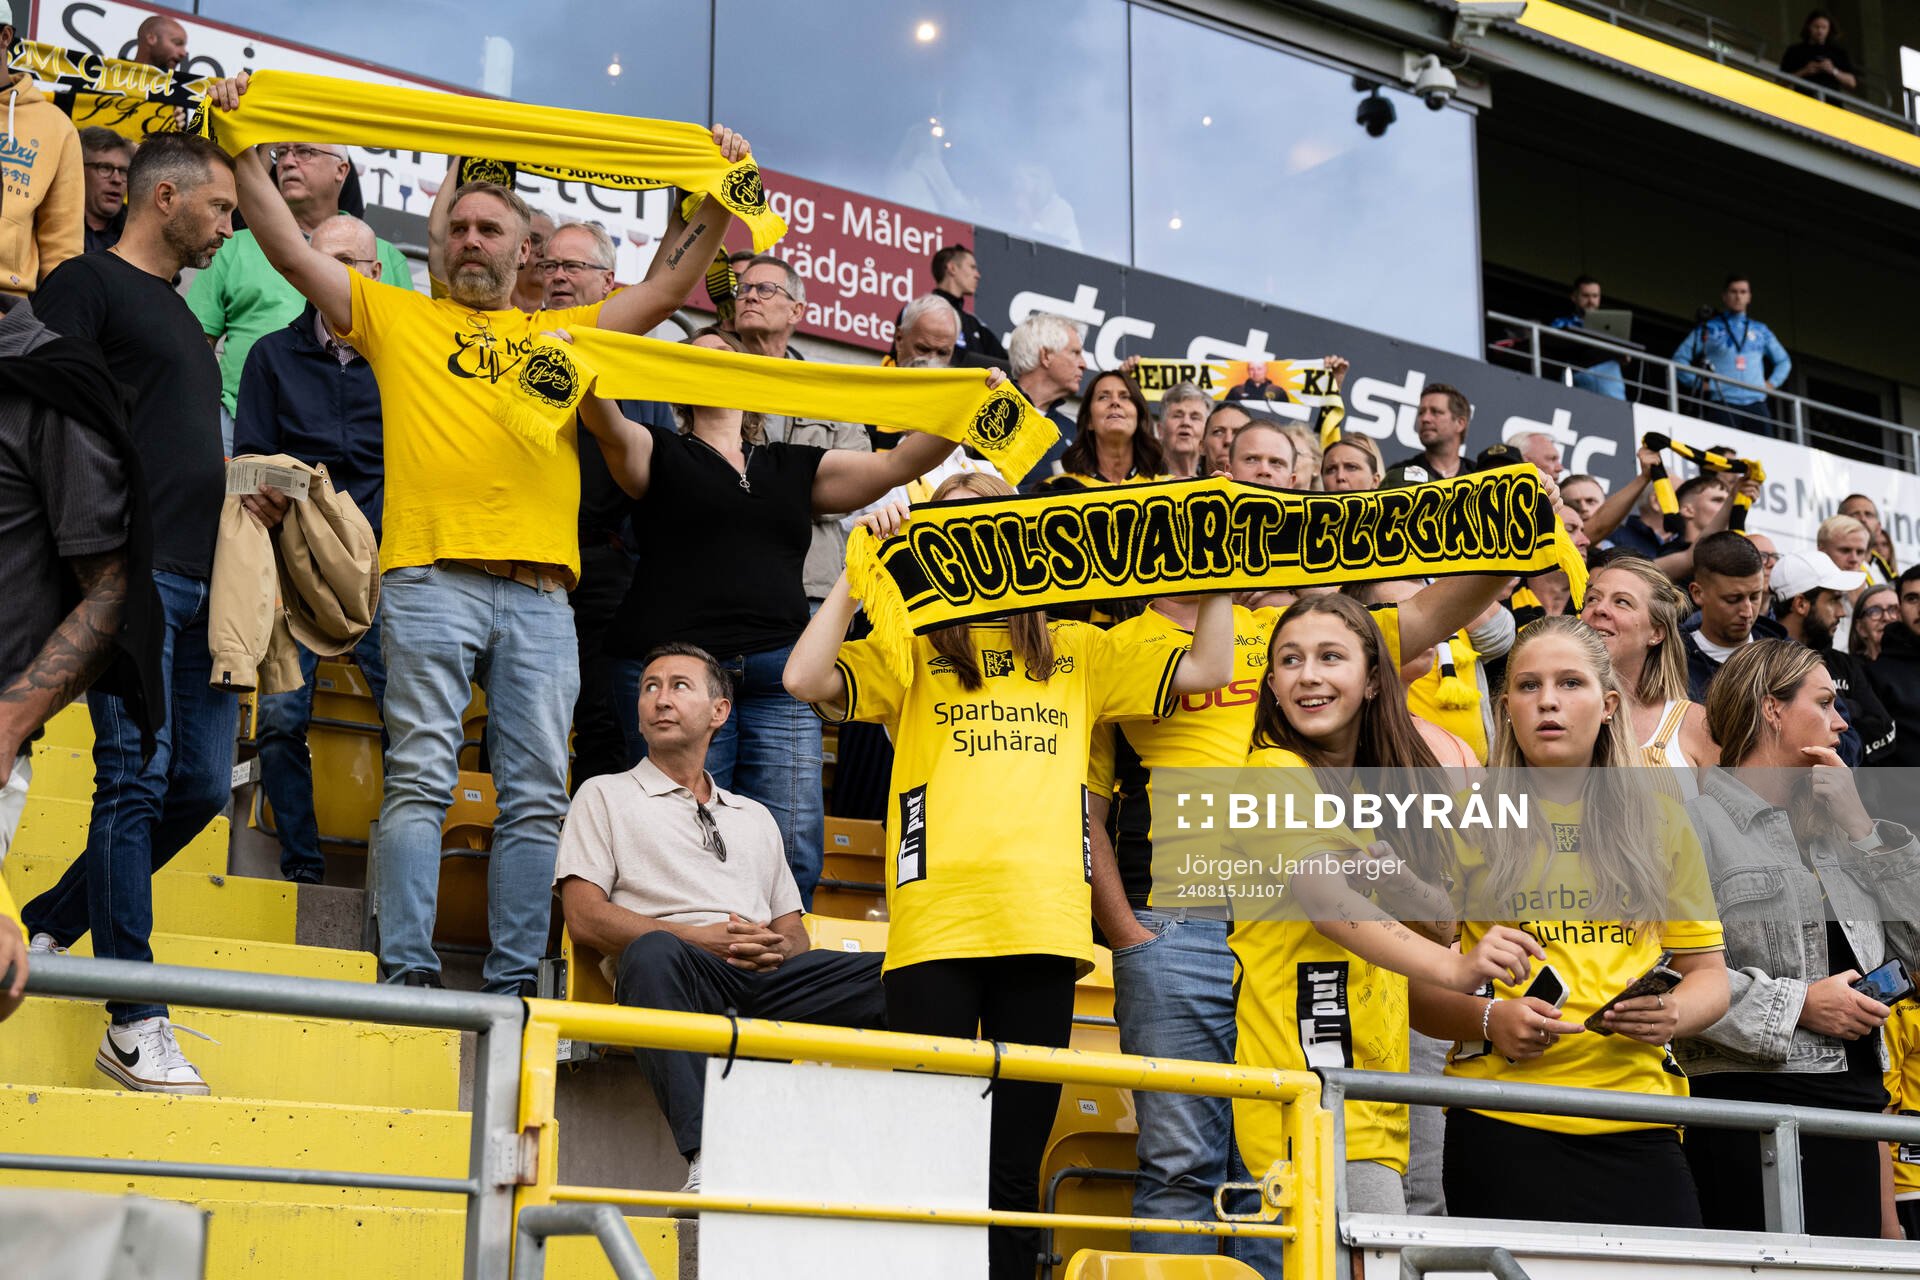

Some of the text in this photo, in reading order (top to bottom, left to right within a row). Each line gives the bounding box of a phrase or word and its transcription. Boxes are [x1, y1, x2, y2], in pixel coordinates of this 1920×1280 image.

[842, 202, 943, 256] Måleri
[910, 472, 1540, 606] GULSVART ELEGANS
[934, 700, 1069, 729] Sparbanken
[952, 729, 1057, 757] Sjuhärad
